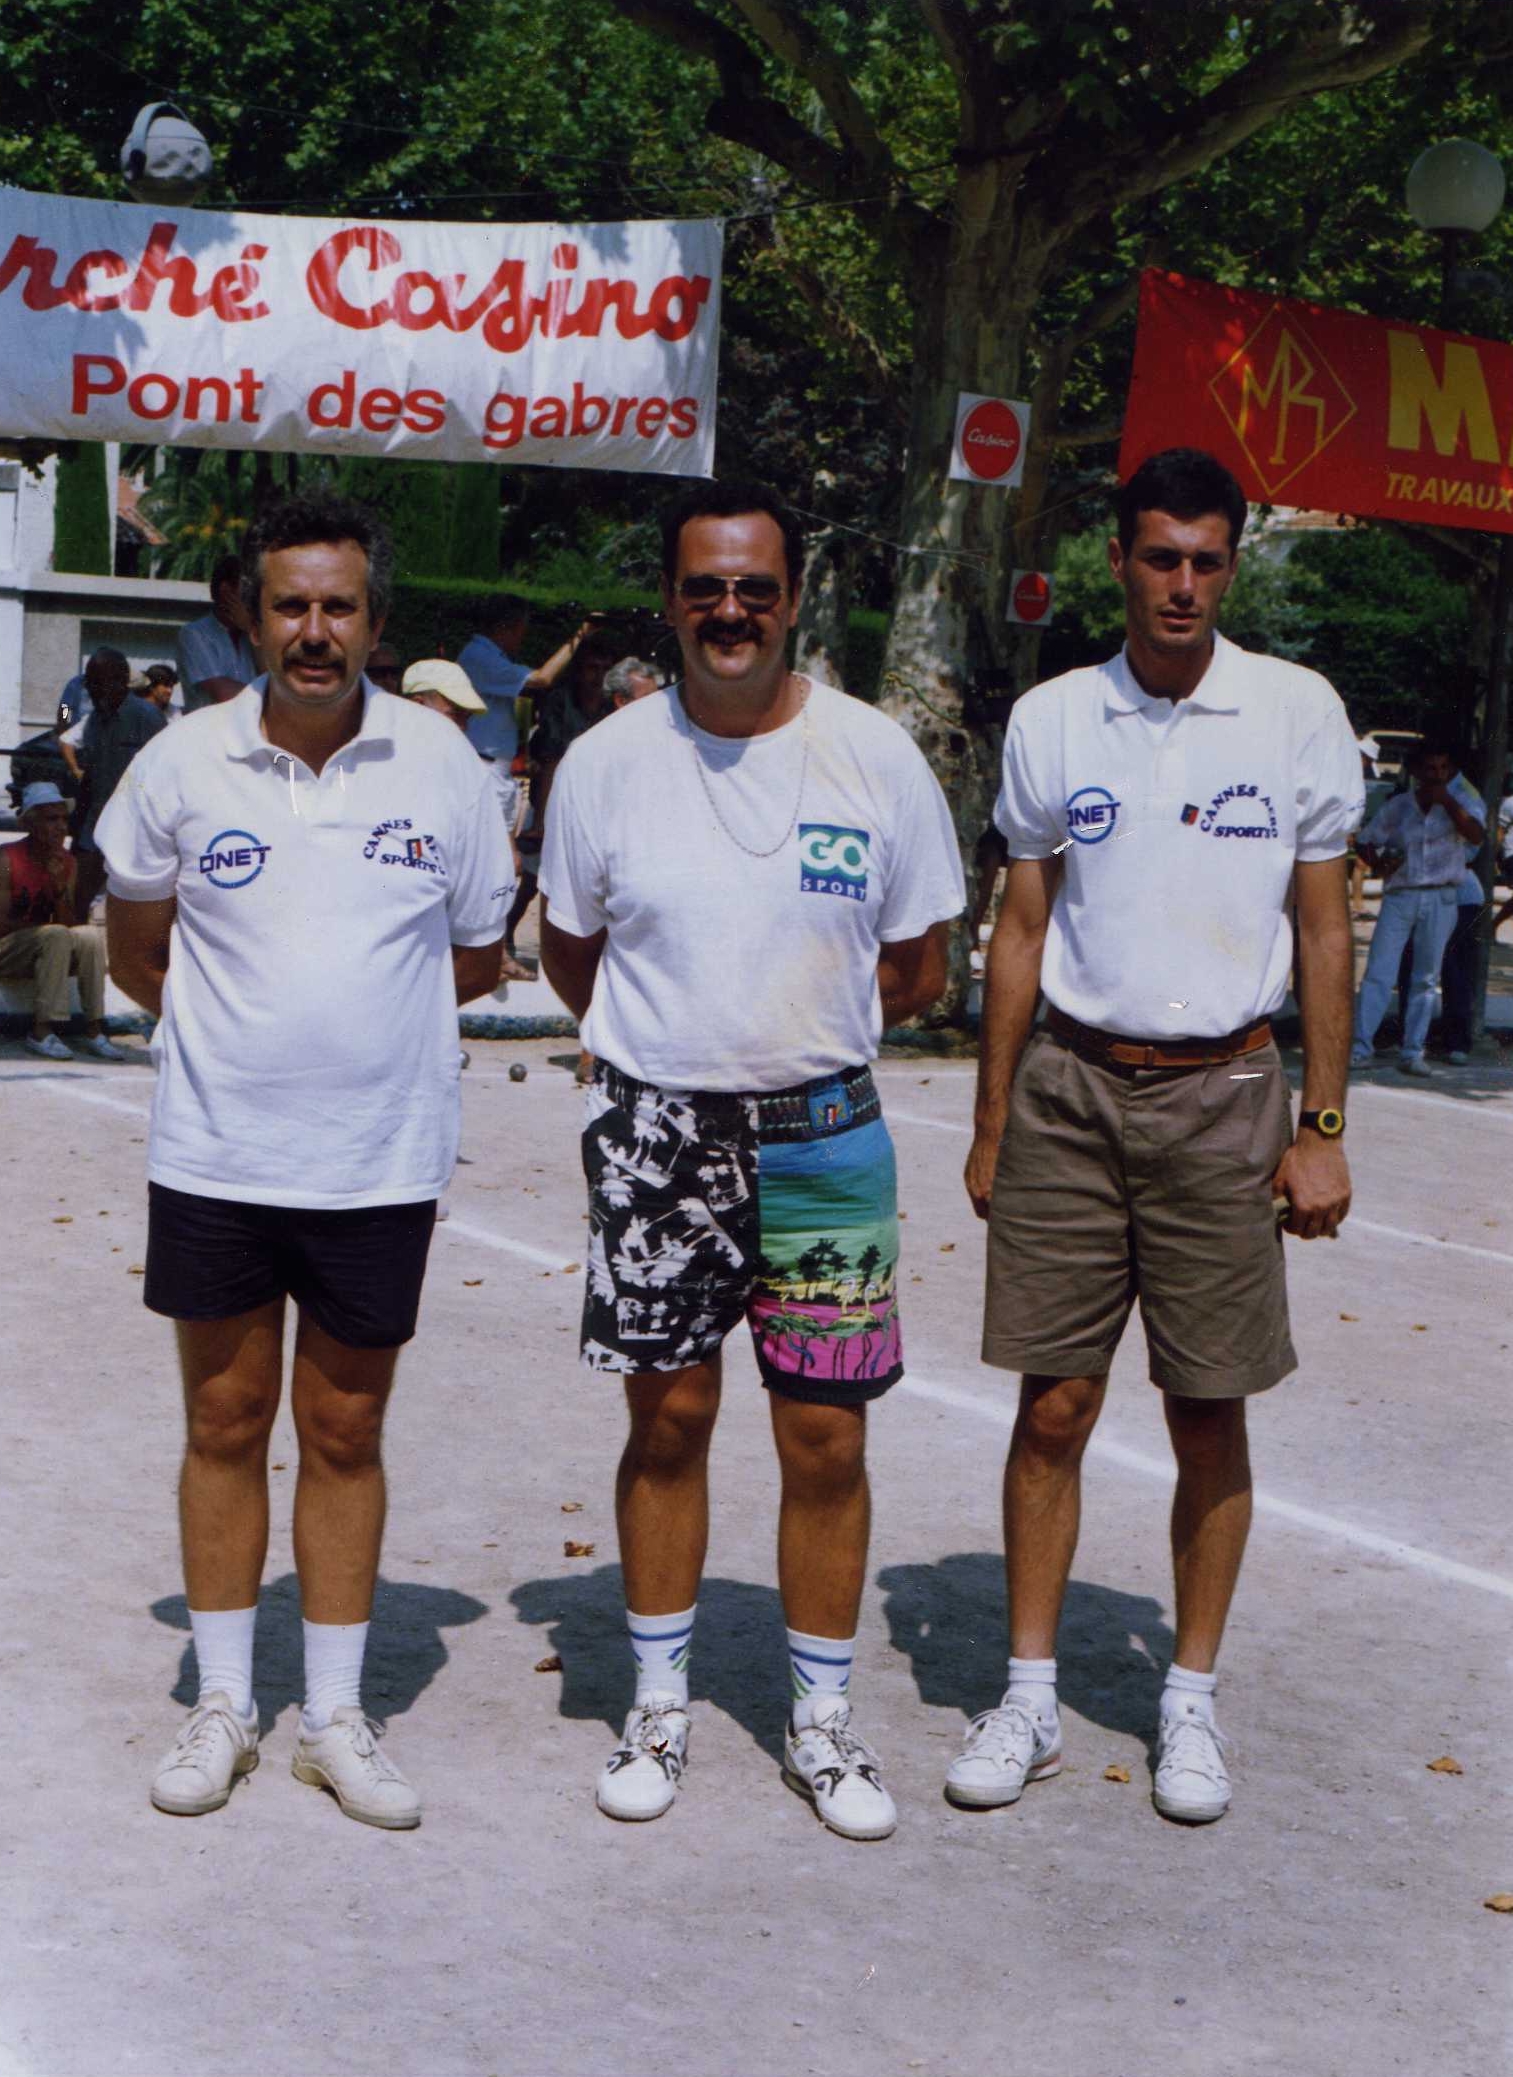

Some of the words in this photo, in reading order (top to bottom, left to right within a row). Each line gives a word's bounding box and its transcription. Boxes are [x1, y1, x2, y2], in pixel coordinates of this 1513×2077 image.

[307, 227, 711, 353] Casino
[71, 353, 264, 423] Pont
[307, 371, 446, 433] des
[482, 382, 698, 449] gabres
[1387, 329, 1513, 468] M
[968, 427, 1016, 448] Casino
[1385, 472, 1513, 515] TRAVAUX
[1200, 784, 1258, 832] CANNES
[199, 846, 272, 874] ONET
[363, 819, 412, 860] CANNES
[799, 831, 869, 877] GO
[802, 878, 866, 900] SPORT
